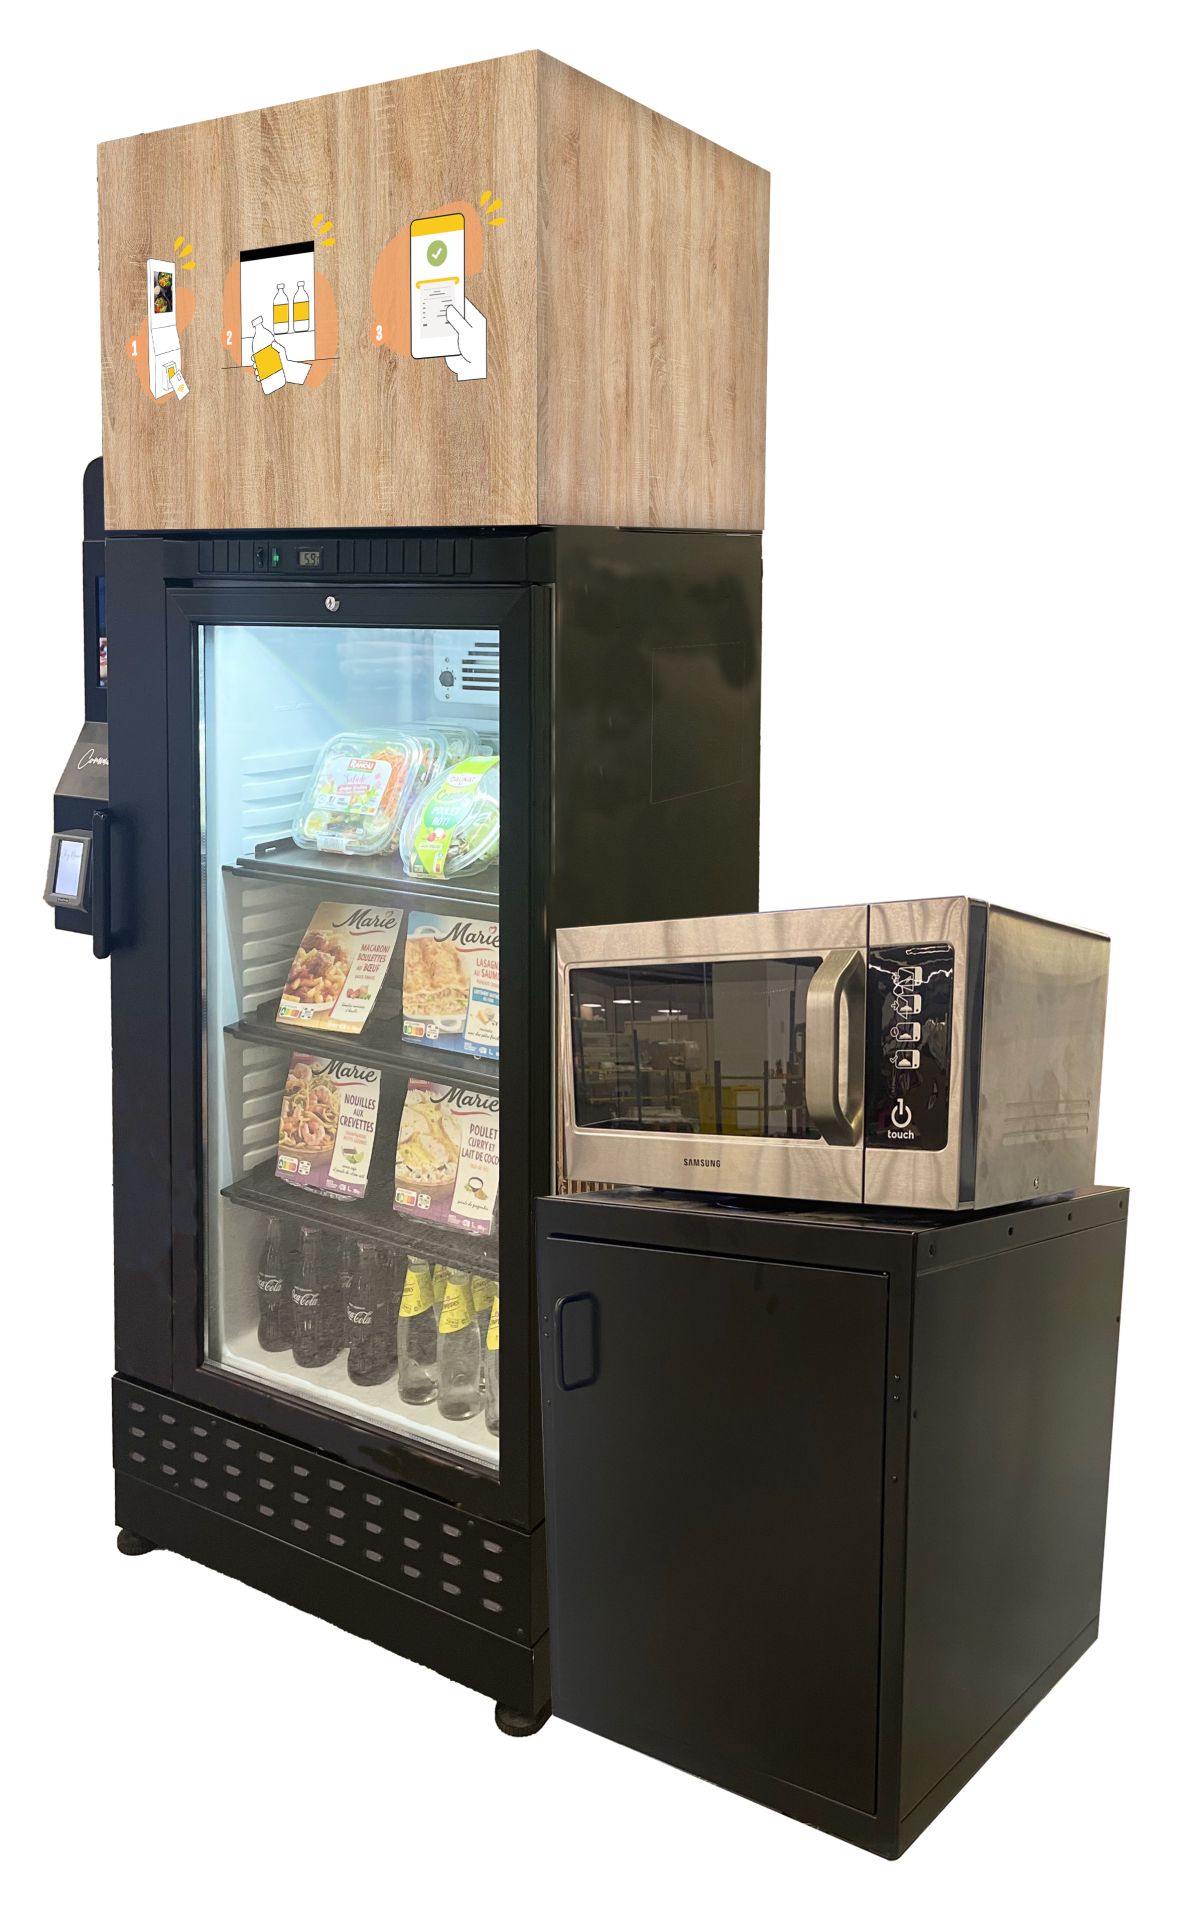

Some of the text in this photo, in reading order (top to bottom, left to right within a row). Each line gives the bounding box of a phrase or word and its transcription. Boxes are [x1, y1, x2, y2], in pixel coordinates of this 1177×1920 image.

[226, 331, 232, 346] 2
[376, 325, 382, 341] 3
[131, 341, 138, 356] 1
[332, 909, 398, 930] Marie
[434, 922, 499, 947] Marie
[360, 943, 390, 953] MACARONI
[357, 952, 387, 963] BOULETTES
[476, 958, 499, 970] LASAGN
[481, 968, 498, 979] SAUM
[312, 1059, 378, 1083] Marie
[344, 1093, 376, 1110] NOUILLES
[430, 1086, 499, 1112] Marie
[353, 1108, 364, 1117] AUX
[339, 1115, 375, 1133] CREVETTES
[469, 1123, 498, 1140] POULET
[887, 1129, 915, 1140] touch
[468, 1137, 496, 1152] CURRY ET
[461, 1147, 499, 1165] LAIT DE COCO
[683, 1158, 721, 1168] SAMSUNG
